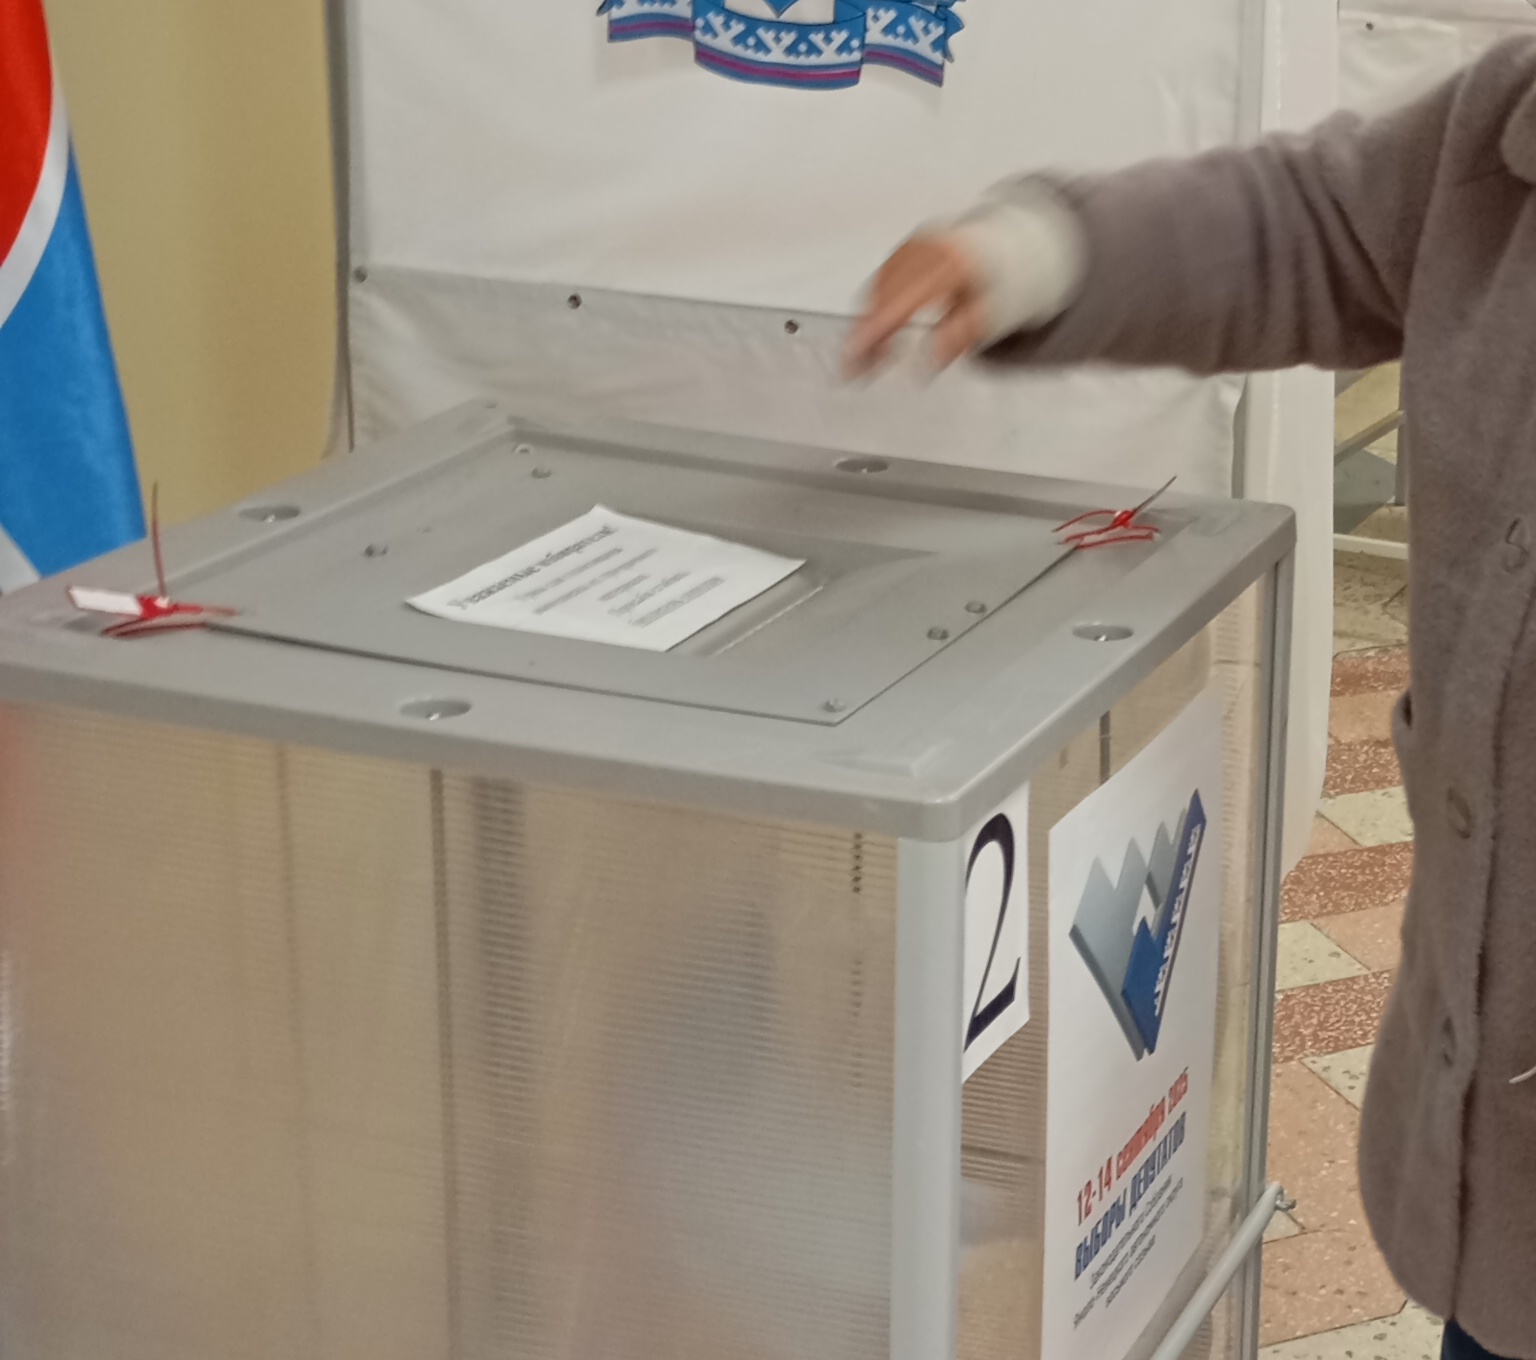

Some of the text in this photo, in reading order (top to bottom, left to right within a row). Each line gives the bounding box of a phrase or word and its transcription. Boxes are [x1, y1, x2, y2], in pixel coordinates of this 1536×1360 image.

[963, 812, 1021, 1054] 2
[1074, 1186, 1127, 1282] ВЫБОРЫ
[1128, 1111, 1186, 1217] ДЕПУТАТОВ
[1077, 1155, 1114, 1227] 12-14
